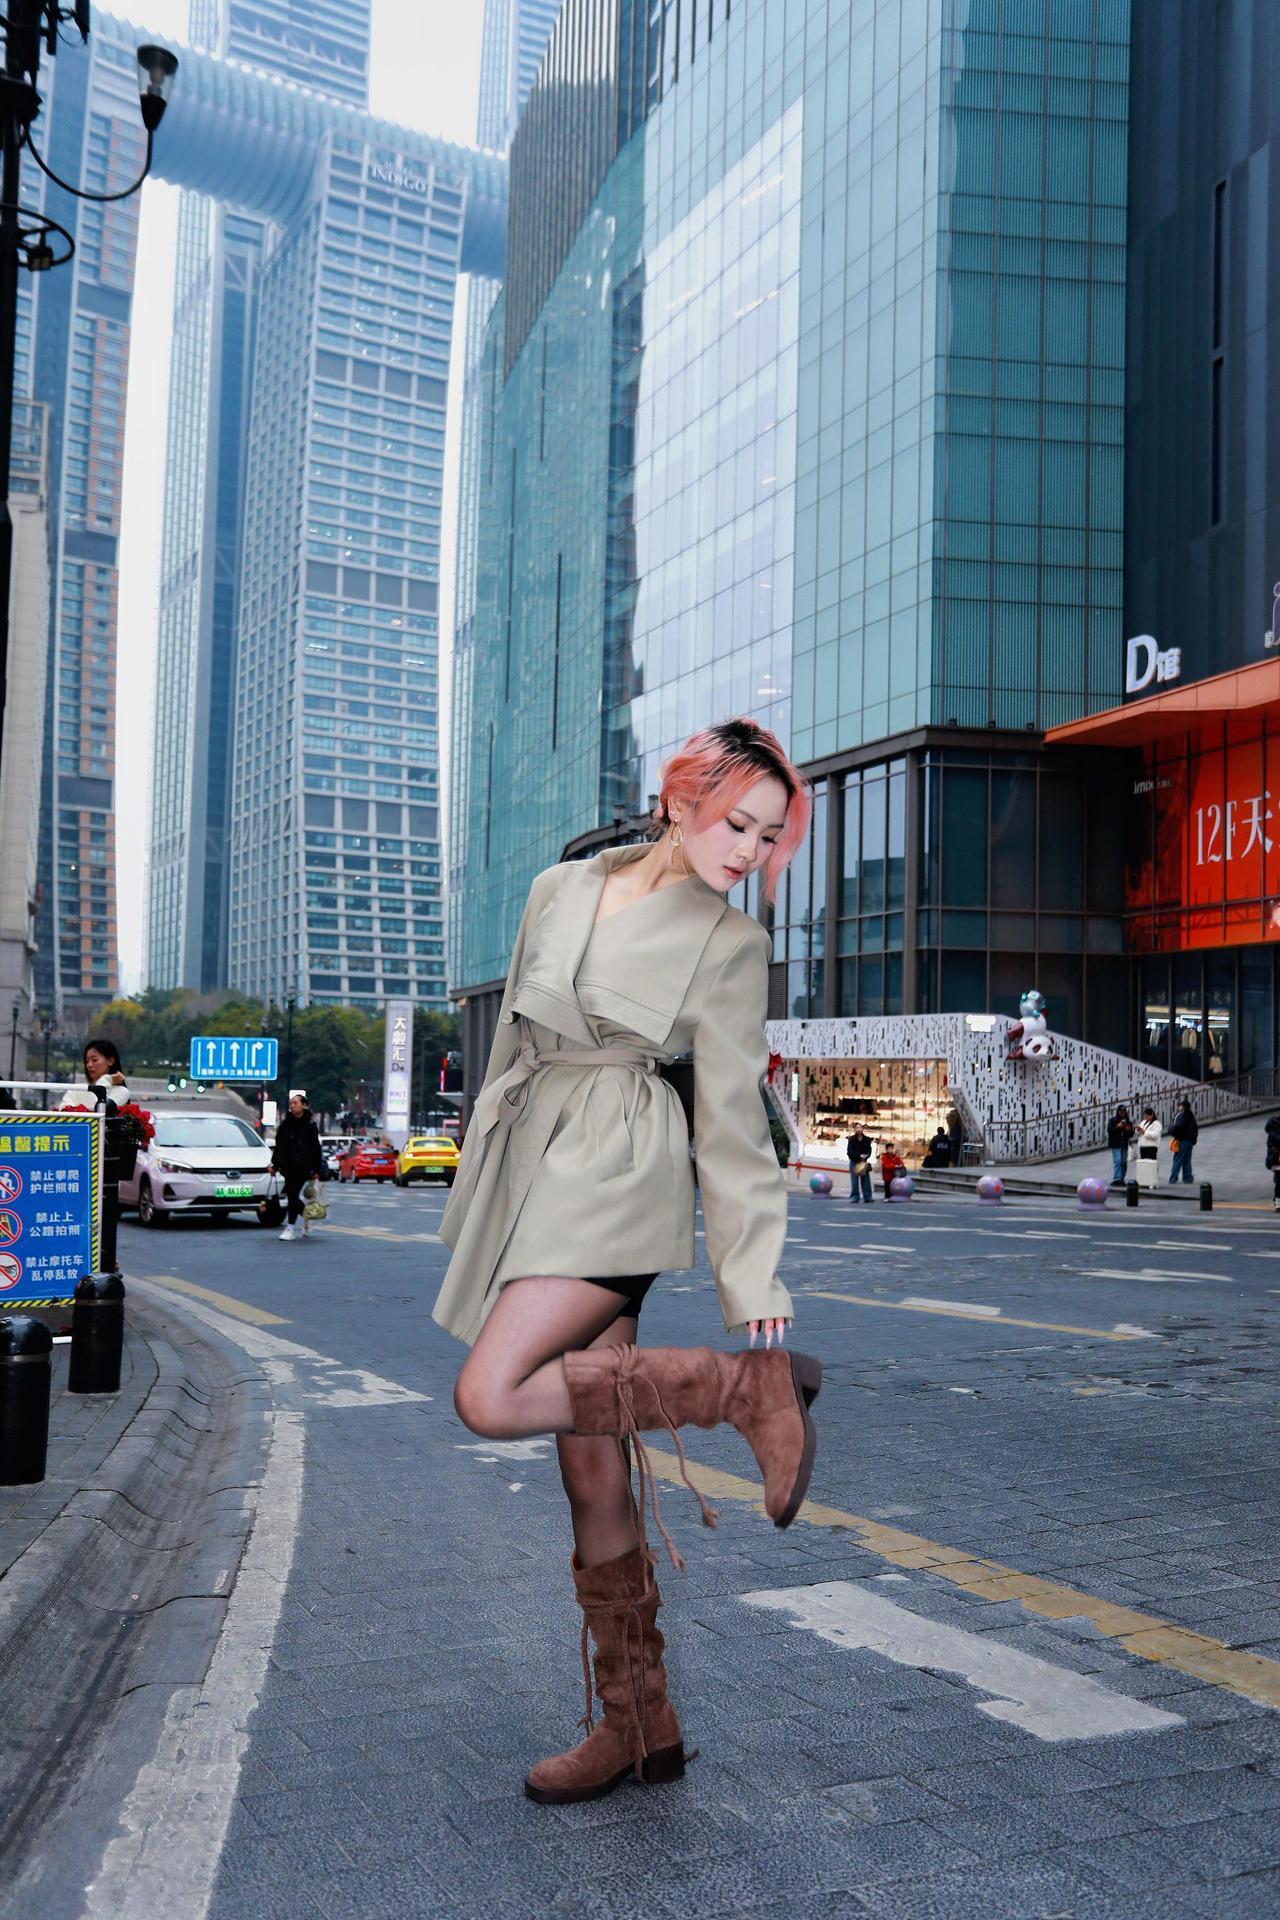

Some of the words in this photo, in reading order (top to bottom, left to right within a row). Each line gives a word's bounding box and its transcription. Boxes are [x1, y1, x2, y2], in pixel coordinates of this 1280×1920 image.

[0, 1135, 70, 1152] 温馨提示
[30, 1169, 79, 1181] 禁止攀爬
[30, 1182, 79, 1194] 护栏照相
[35, 1211, 74, 1223] 禁止上
[29, 1224, 80, 1237] 公路拍照
[25, 1254, 84, 1268] 禁止摩托车
[31, 1268, 78, 1281] 乱停乱放
